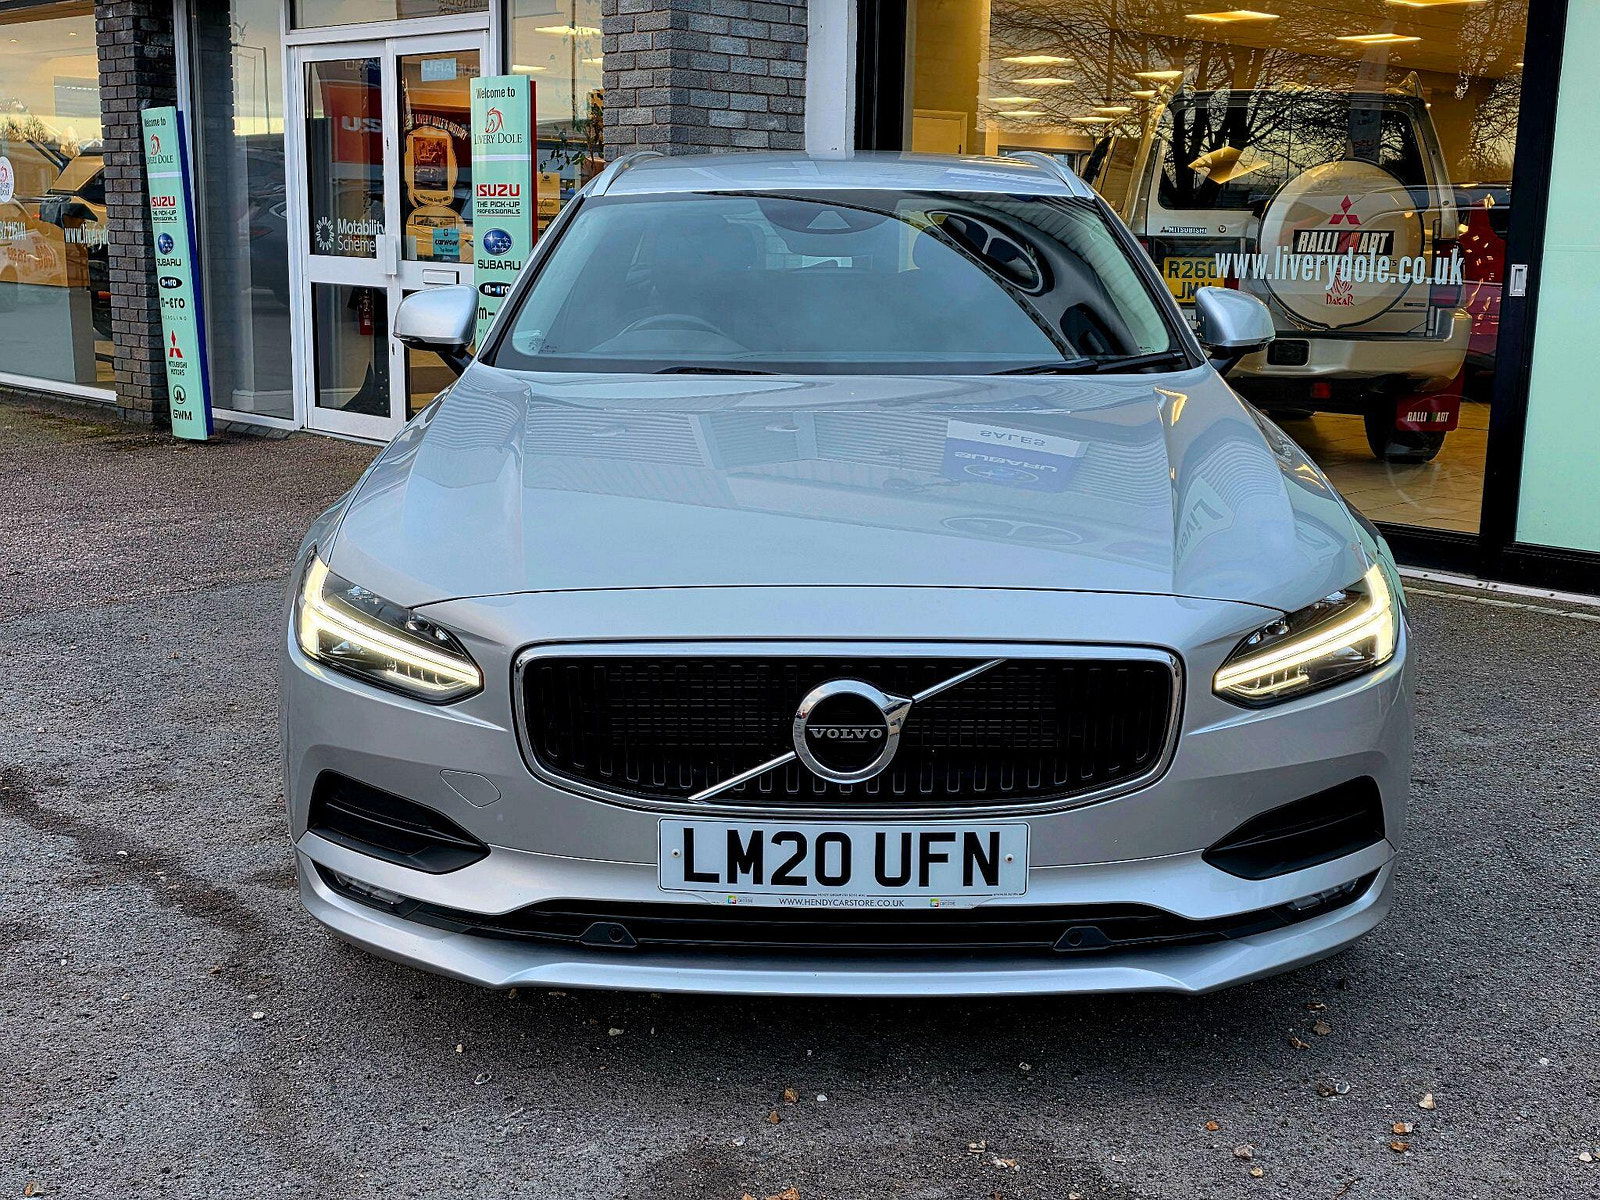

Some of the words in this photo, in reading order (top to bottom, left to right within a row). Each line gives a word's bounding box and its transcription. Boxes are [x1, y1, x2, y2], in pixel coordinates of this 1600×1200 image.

[476, 87, 505, 99] Welcome
[507, 86, 516, 98] to
[474, 133, 495, 145] LIVERY
[497, 132, 523, 144] DOLE
[157, 154, 174, 164] DOLE
[476, 184, 520, 197] ISUZU
[1168, 226, 1207, 234] MITSUBISHI
[337, 235, 376, 253] Scheme
[477, 259, 521, 270] SUBARU
[1215, 245, 1465, 291] www.liverydole.co.uk
[172, 409, 192, 420] GWM
[808, 728, 883, 739] VOLVO
[682, 827, 852, 888] LM20
[874, 831, 1001, 888] UFN
[778, 896, 905, 908] WWW.HENDYCARSTORE.CO.UK
